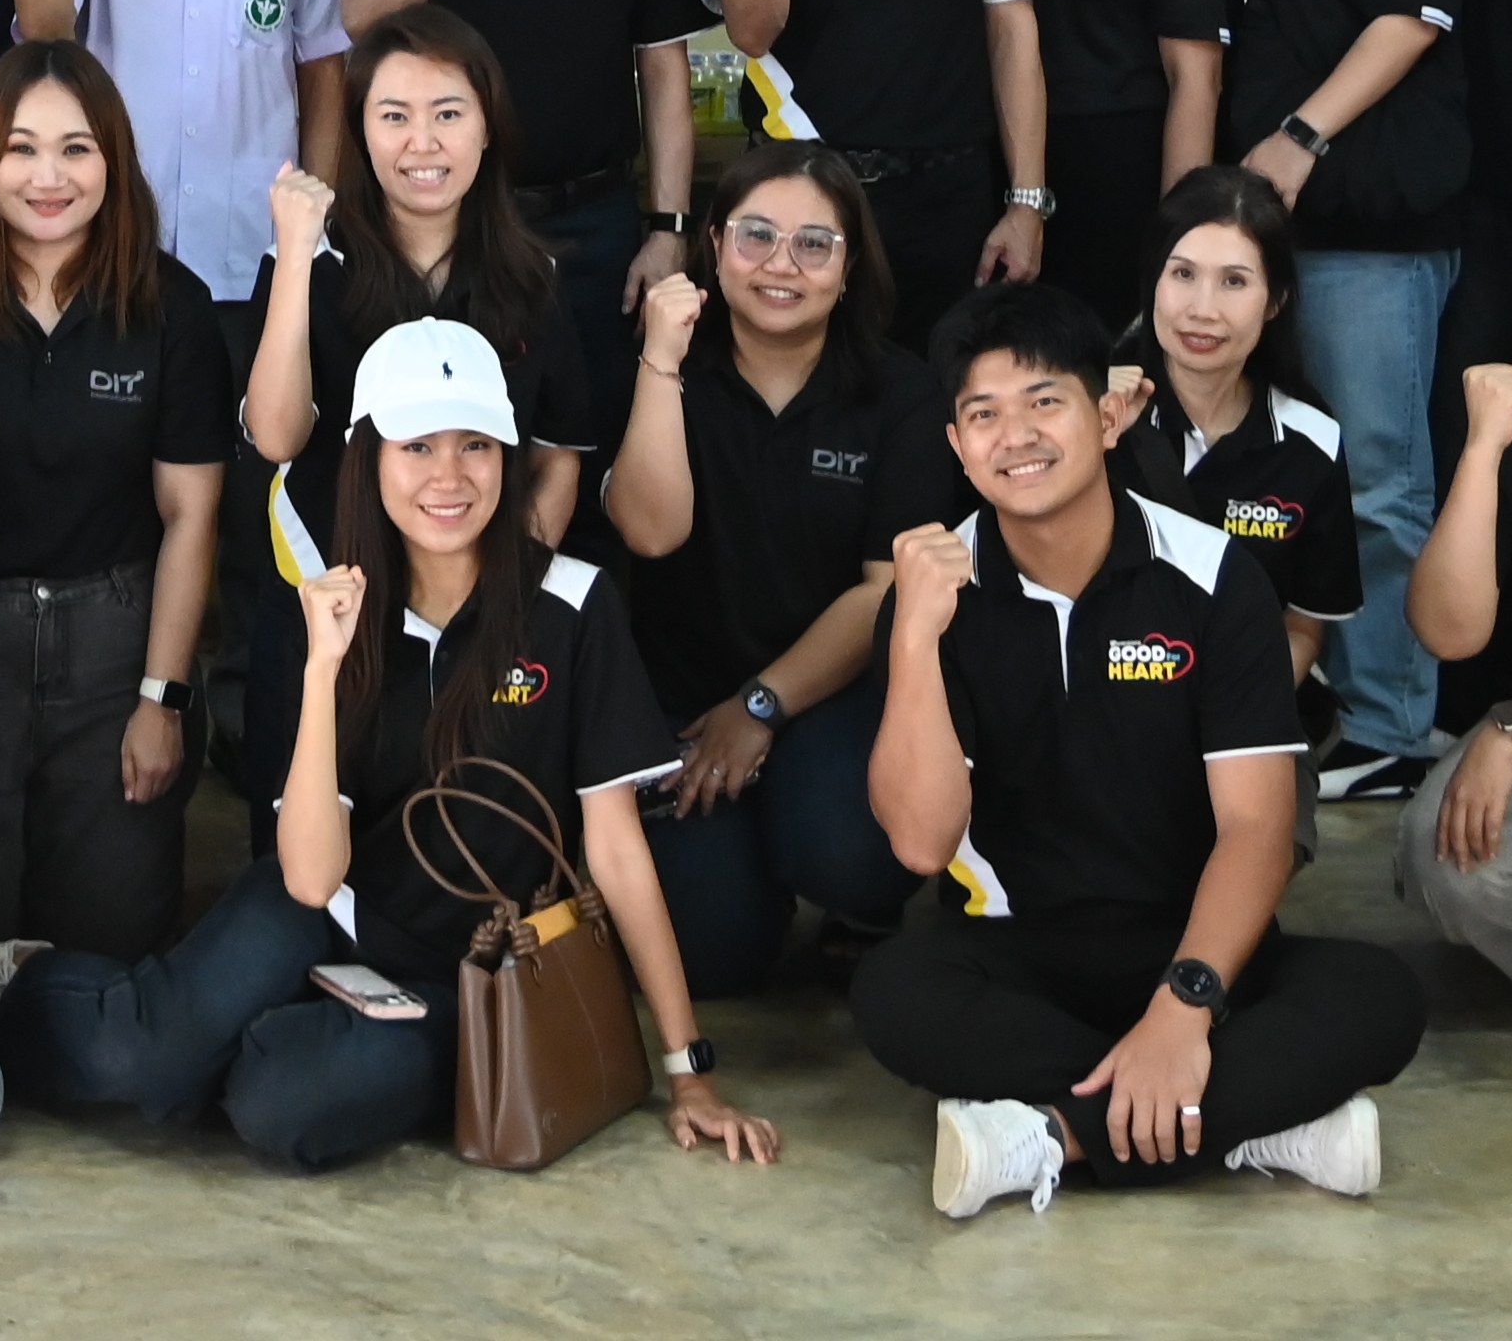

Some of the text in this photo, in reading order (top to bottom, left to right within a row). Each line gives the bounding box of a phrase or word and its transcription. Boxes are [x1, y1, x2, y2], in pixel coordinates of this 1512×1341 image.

[89, 369, 144, 394] DIT
[810, 448, 868, 476] DIT
[1225, 504, 1280, 524] GOOD
[1223, 519, 1288, 539] HEART
[1108, 645, 1167, 664] GOOD
[1108, 661, 1178, 681] HEART
[492, 683, 533, 705] ART
